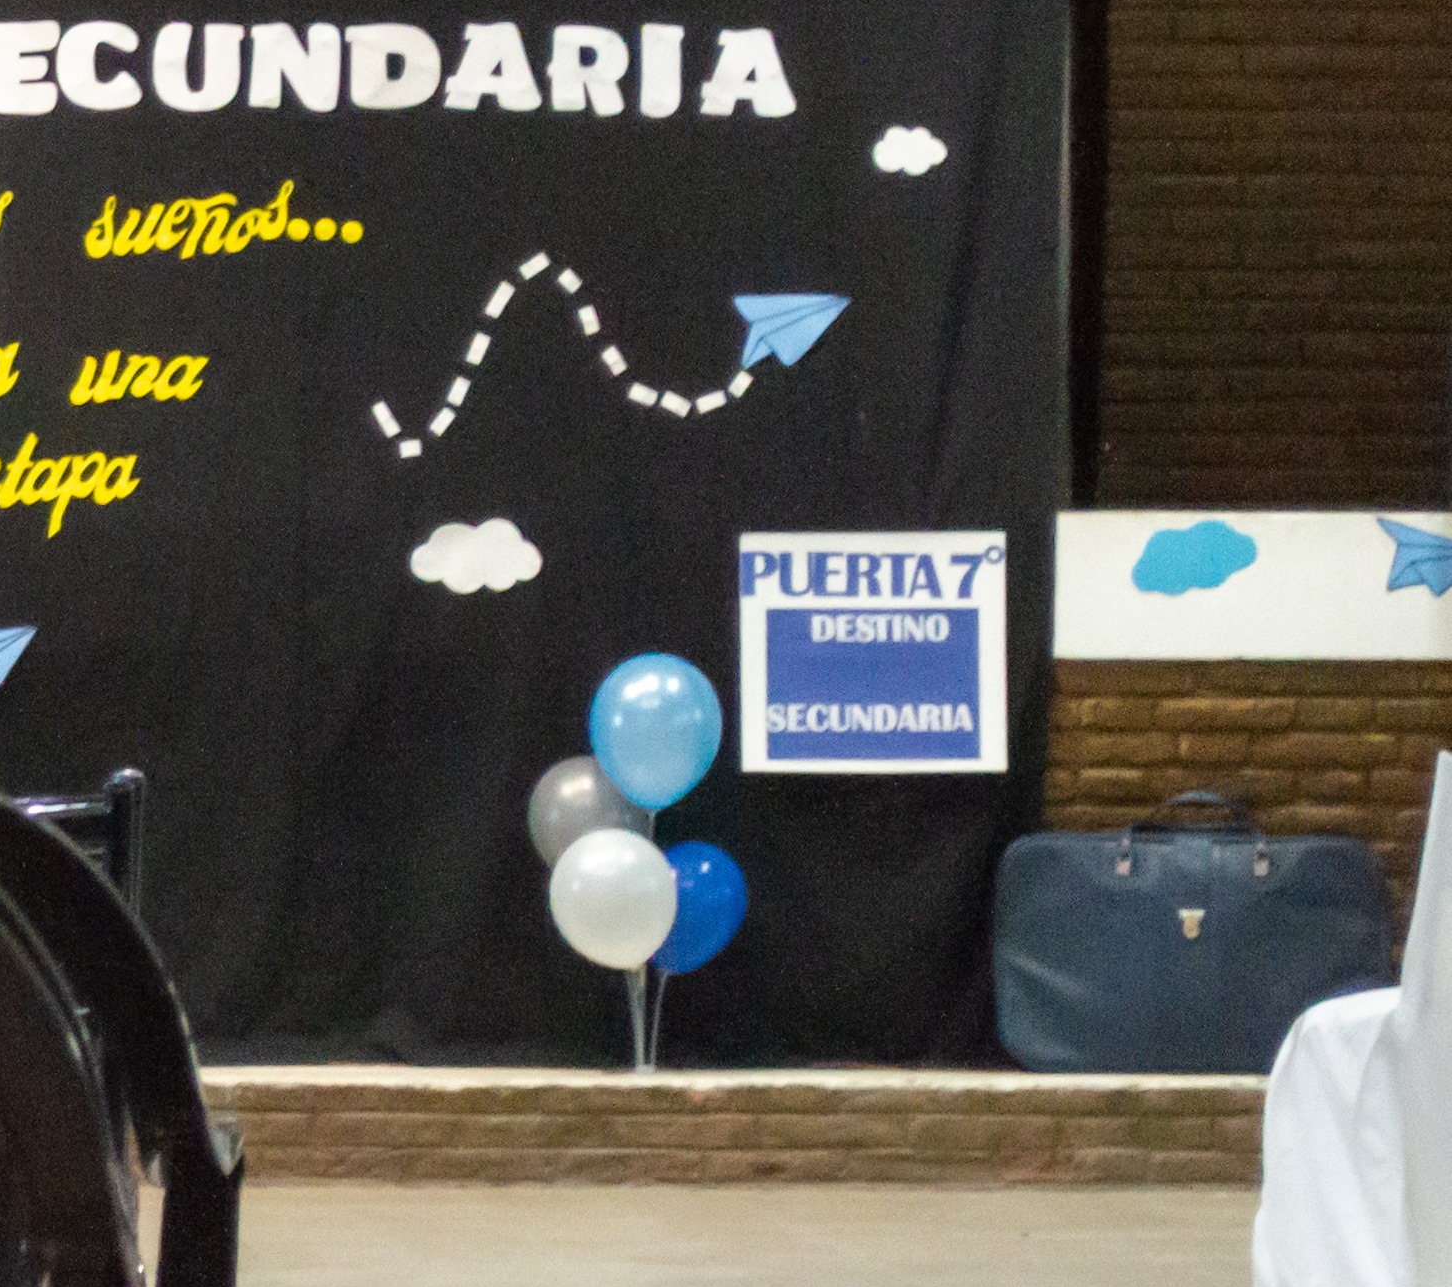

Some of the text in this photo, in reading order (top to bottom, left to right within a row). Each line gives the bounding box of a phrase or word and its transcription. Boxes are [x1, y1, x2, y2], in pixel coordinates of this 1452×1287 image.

[68, 348, 210, 407] una
[739, 549, 943, 599] PUERTA
[809, 611, 951, 644] DESTINO
[766, 702, 975, 734] SECUNDARIA
